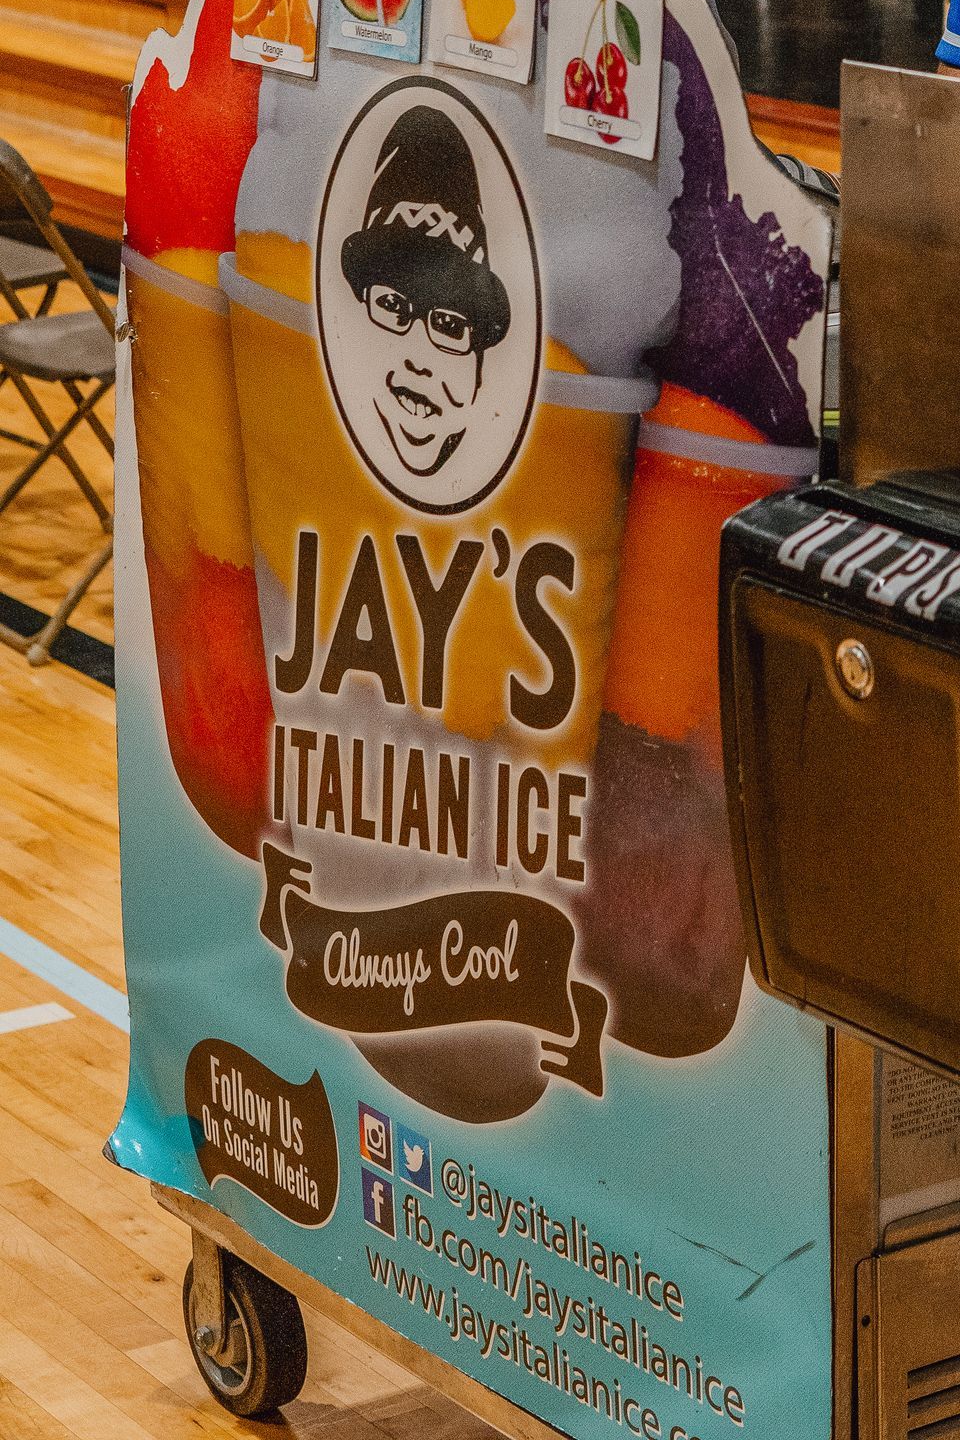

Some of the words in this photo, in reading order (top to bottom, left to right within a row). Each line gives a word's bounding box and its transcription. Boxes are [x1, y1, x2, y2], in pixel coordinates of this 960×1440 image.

[262, 41, 284, 57] Orange
[355, 25, 392, 42] Watermelon
[469, 43, 493, 60] Mango
[587, 114, 613, 133] Cherry
[274, 527, 577, 730] JAY'S
[273, 725, 470, 859] ITALIAN
[496, 763, 587, 883] ICE
[324, 927, 431, 1016] Always
[440, 919, 519, 987] Cool
[210, 1054, 271, 1136] Follow
[278, 1095, 304, 1156] Us
[202, 1104, 221, 1148] On
[223, 1118, 269, 1179] Social
[273, 1148, 319, 1210] Media
[441, 1158, 684, 1322] @jaysitalianice
[402, 1194, 746, 1428] fb.com/jaysitalianice
